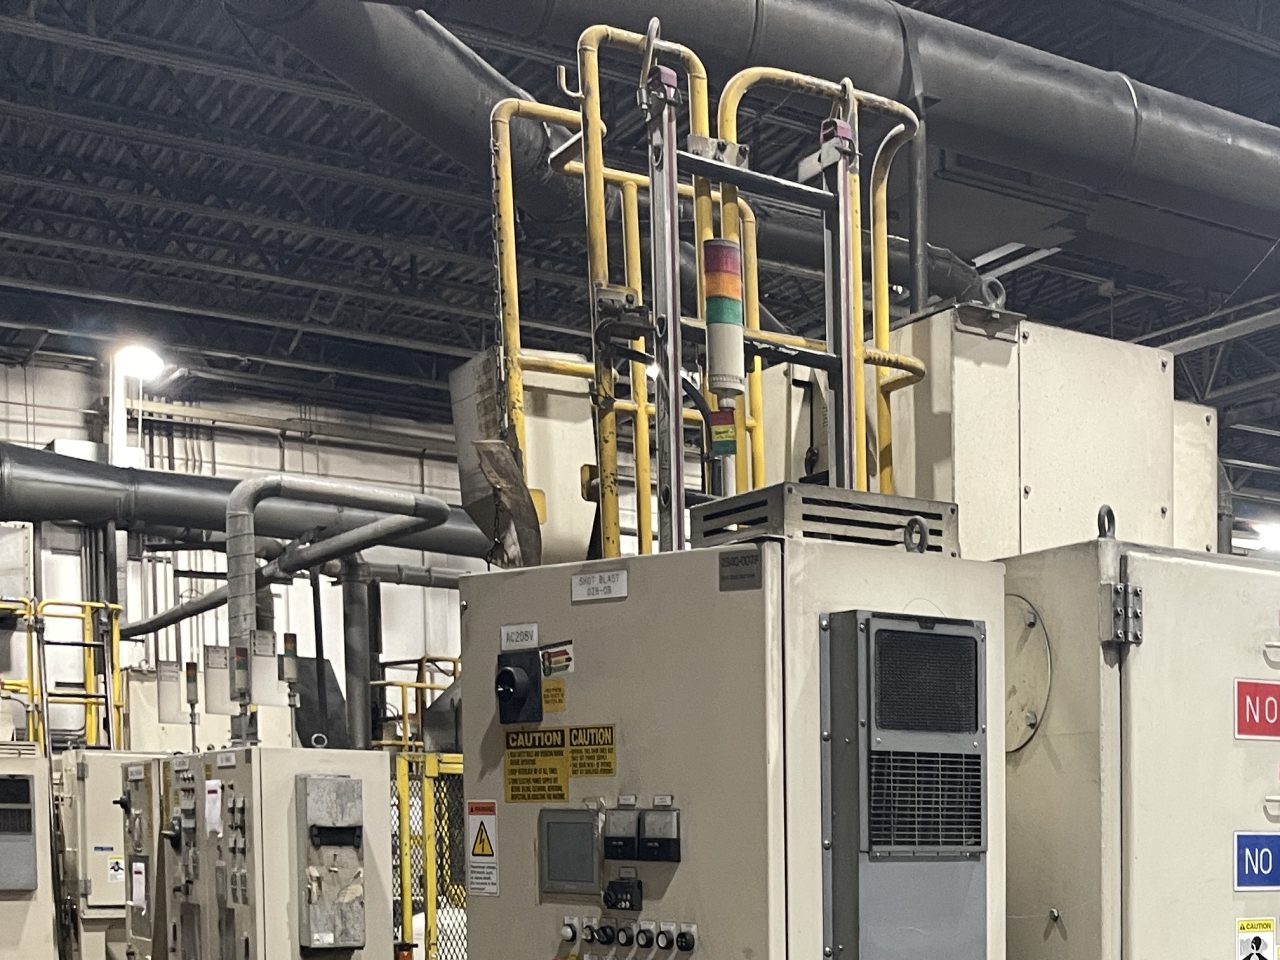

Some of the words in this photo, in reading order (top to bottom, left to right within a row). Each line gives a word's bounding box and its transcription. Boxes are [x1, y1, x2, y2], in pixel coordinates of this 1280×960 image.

[579, 575, 595, 586] SHOT
[599, 573, 620, 584] BLAST
[506, 630, 534, 644] AC208V
[1246, 695, 1278, 723] NO
[509, 731, 562, 747] CAUTION
[571, 728, 612, 746] CAUTION
[1245, 848, 1273, 874] NO
[1246, 922, 1271, 930] CAUTION
